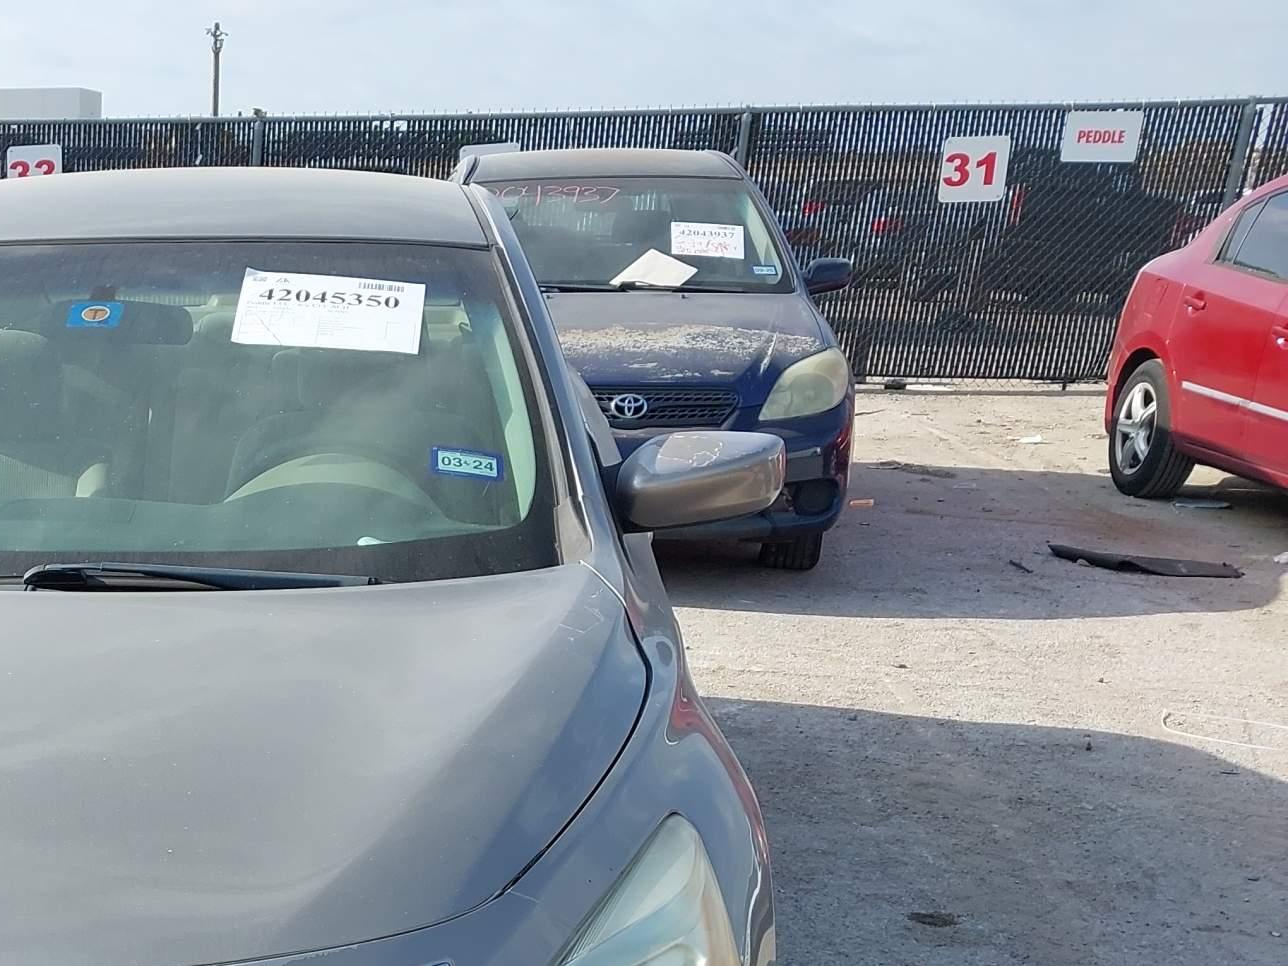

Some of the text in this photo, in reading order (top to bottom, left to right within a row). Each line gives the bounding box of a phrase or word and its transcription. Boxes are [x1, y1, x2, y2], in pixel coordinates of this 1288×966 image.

[1077, 130, 1125, 144] PEDDLE
[942, 151, 997, 187] 31
[259, 288, 401, 310] 42045350
